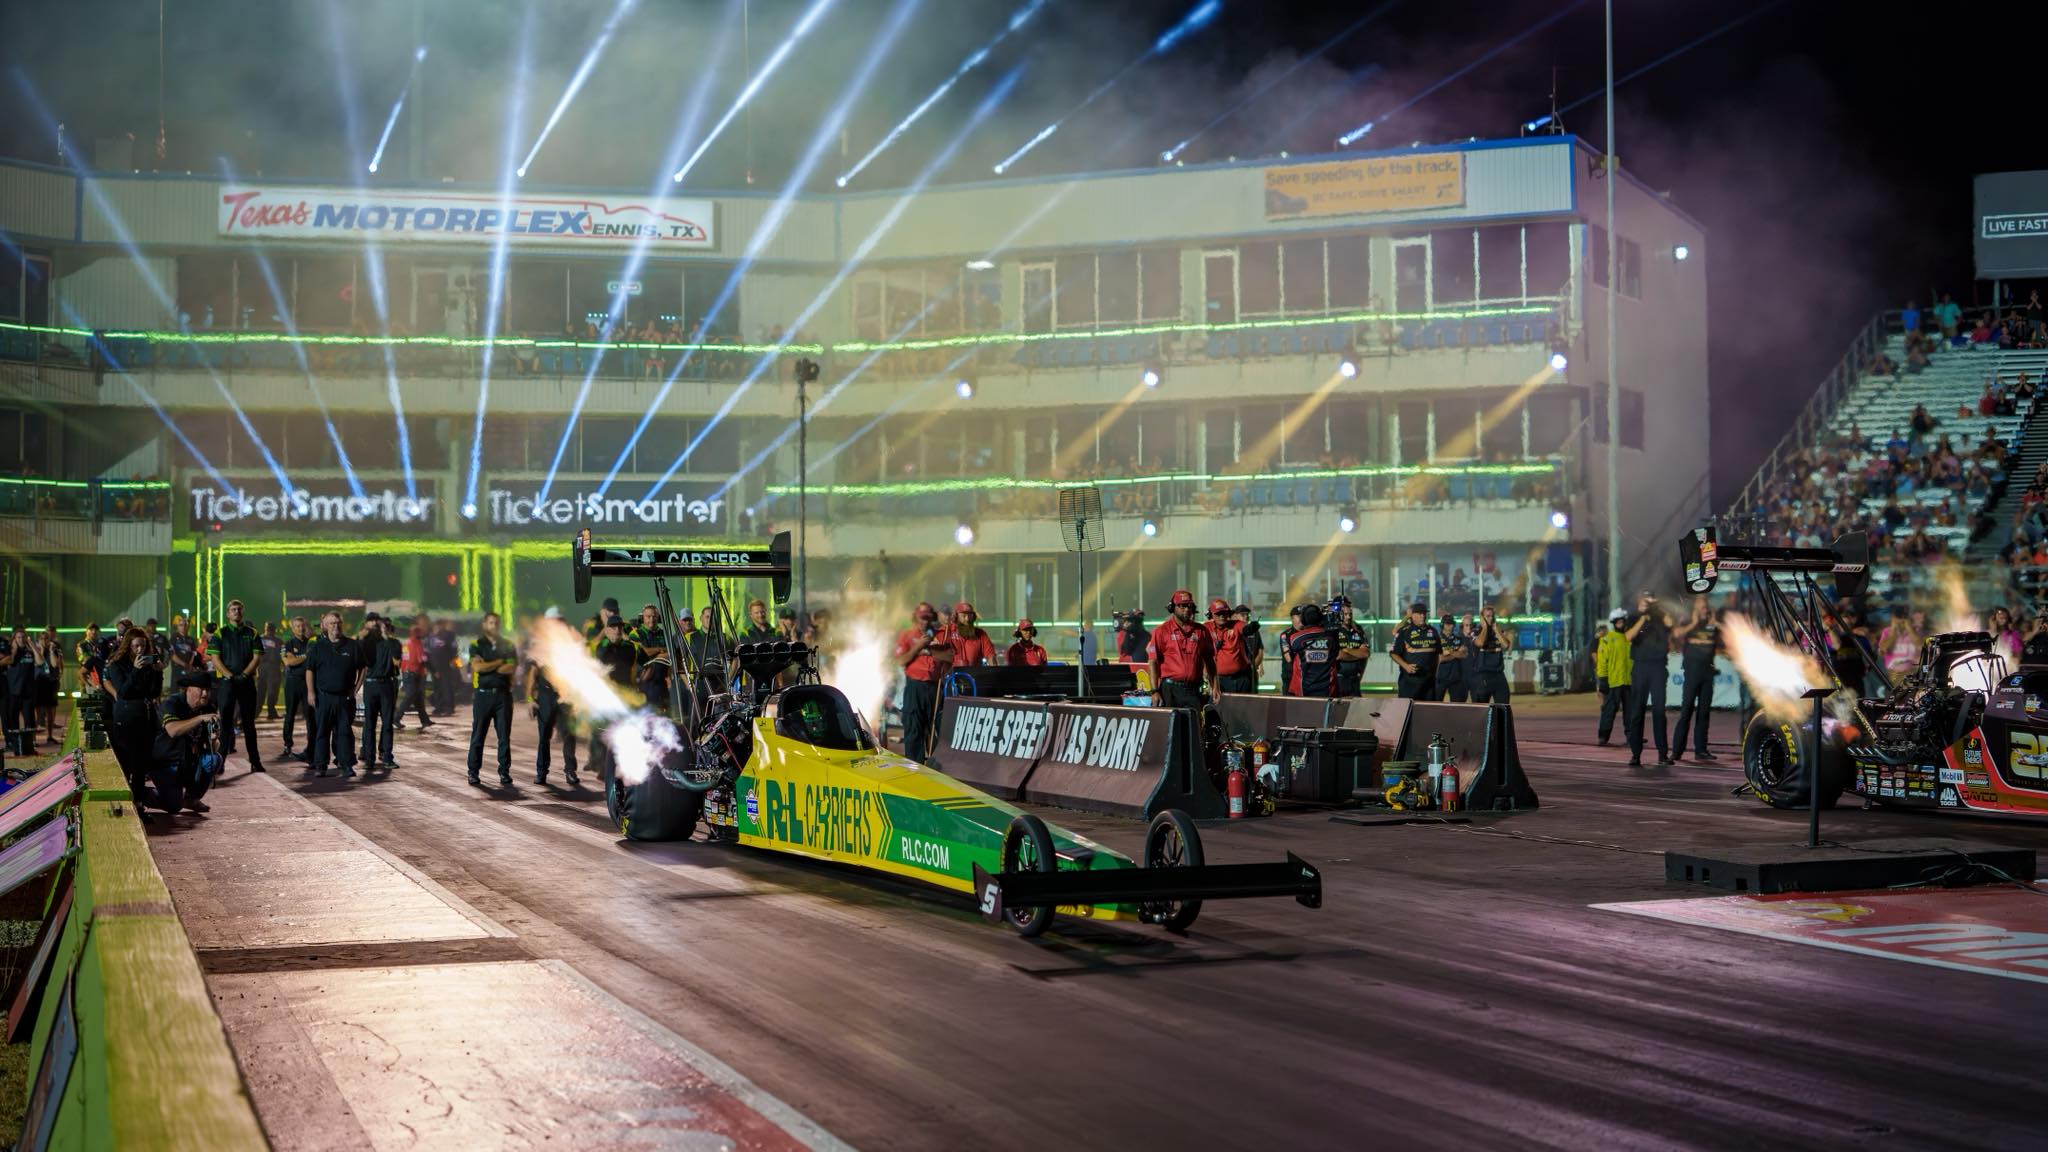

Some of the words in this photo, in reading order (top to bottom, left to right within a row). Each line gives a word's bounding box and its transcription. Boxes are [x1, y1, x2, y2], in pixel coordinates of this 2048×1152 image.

[1390, 162, 1413, 176] the
[223, 191, 312, 232] Texas
[313, 203, 590, 235] MOTORPLEX
[1989, 221, 2015, 232] LIVE
[2018, 219, 2048, 230] FAST
[592, 223, 662, 239] ENNIS,
[670, 225, 694, 238] TX
[192, 488, 433, 523] TicketSmarter
[490, 489, 725, 524] TicketSmarter
[950, 705, 1004, 754] WHERE
[999, 709, 1054, 761] SPEED
[1051, 713, 1091, 764] WAS
[1086, 716, 1150, 772] BORN!
[1941, 771, 1957, 780] Mobil
[766, 779, 803, 844] R+L
[805, 784, 871, 857] CARRIERS
[902, 836, 950, 870] RLC.COM
[981, 883, 998, 914] 5
